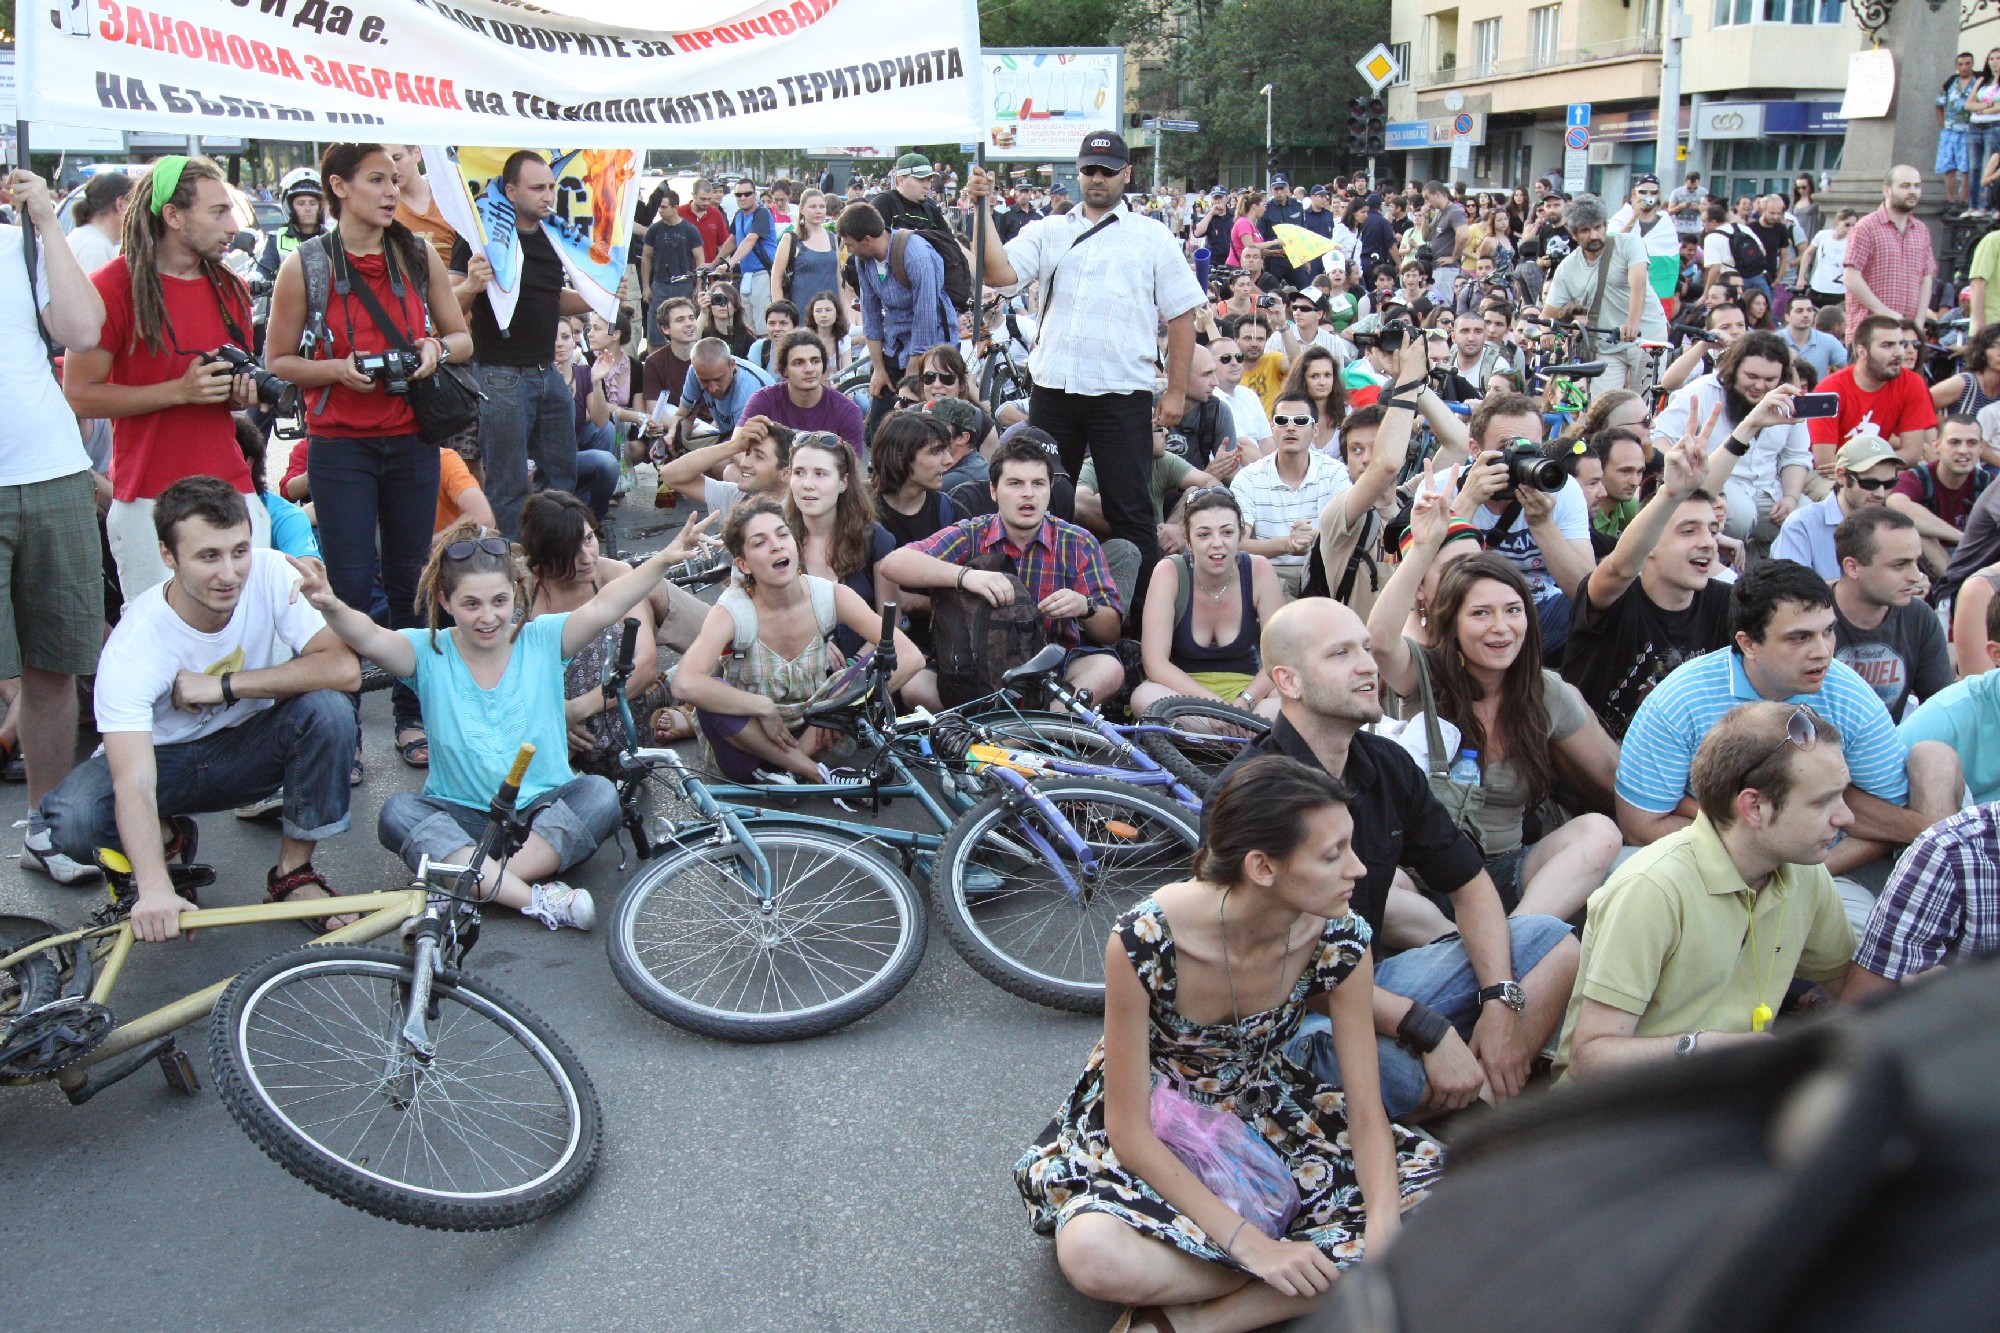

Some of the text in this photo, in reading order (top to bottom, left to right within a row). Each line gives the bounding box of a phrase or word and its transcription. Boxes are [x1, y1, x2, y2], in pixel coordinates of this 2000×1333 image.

[359, 15, 388, 45] е.
[98, 0, 304, 81] ЗАКОНОВА
[303, 54, 463, 110] ЗАБРАНА
[465, 88, 510, 116] на
[737, 85, 778, 114] на
[777, 47, 964, 107] ТЕРИТОРИЯТА
[95, 71, 158, 112] НА
[488, 201, 516, 250] with
